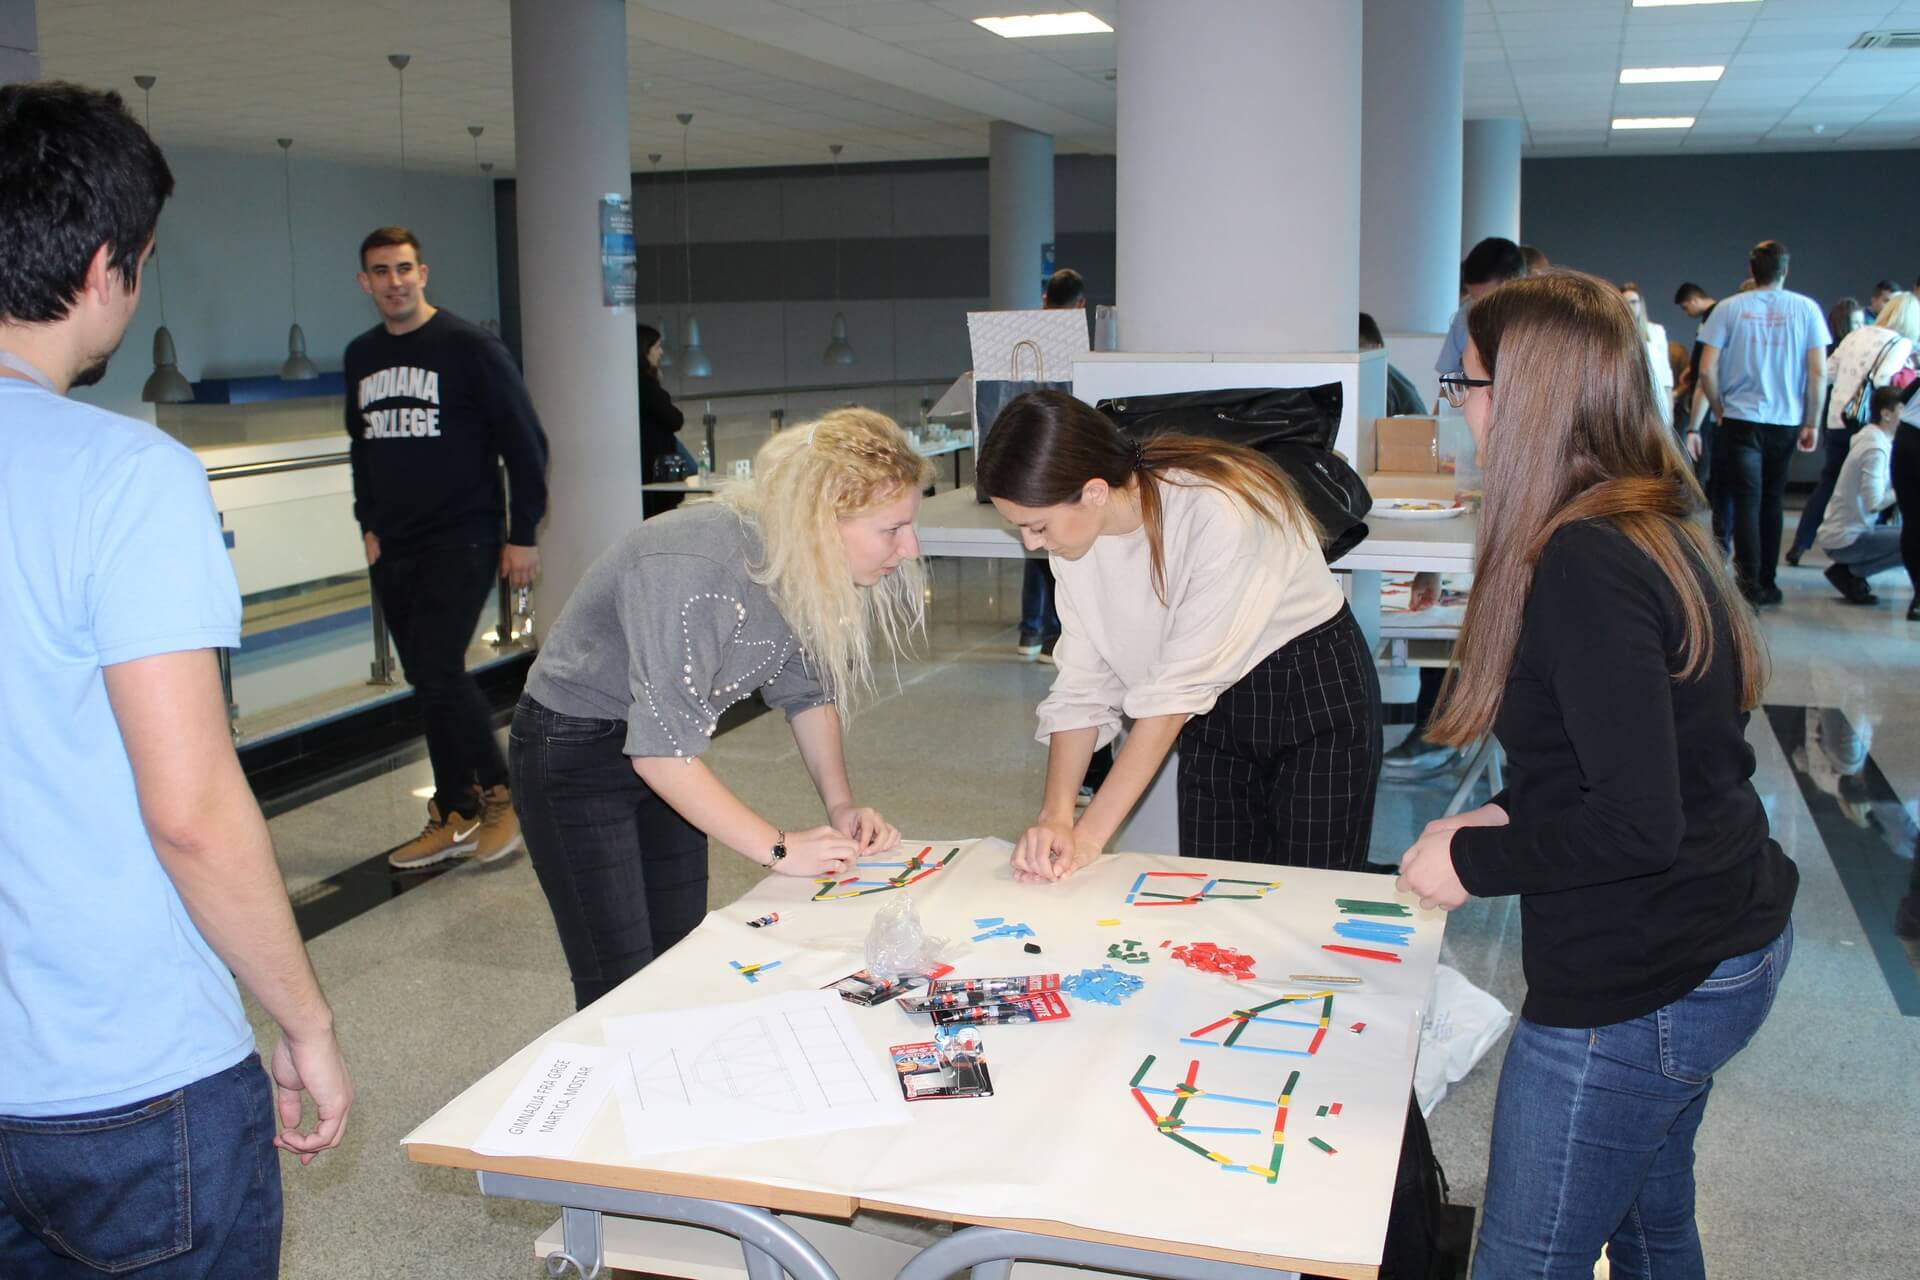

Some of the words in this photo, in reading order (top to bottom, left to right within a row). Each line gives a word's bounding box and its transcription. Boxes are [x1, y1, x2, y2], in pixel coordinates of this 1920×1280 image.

[358, 366, 440, 410] INDIANA
[508, 1095, 547, 1135] GIMNAZIJA
[537, 1080, 557, 1094] FRA
[547, 1059, 571, 1079] GRGE
[563, 1066, 592, 1095] MOSTAR
